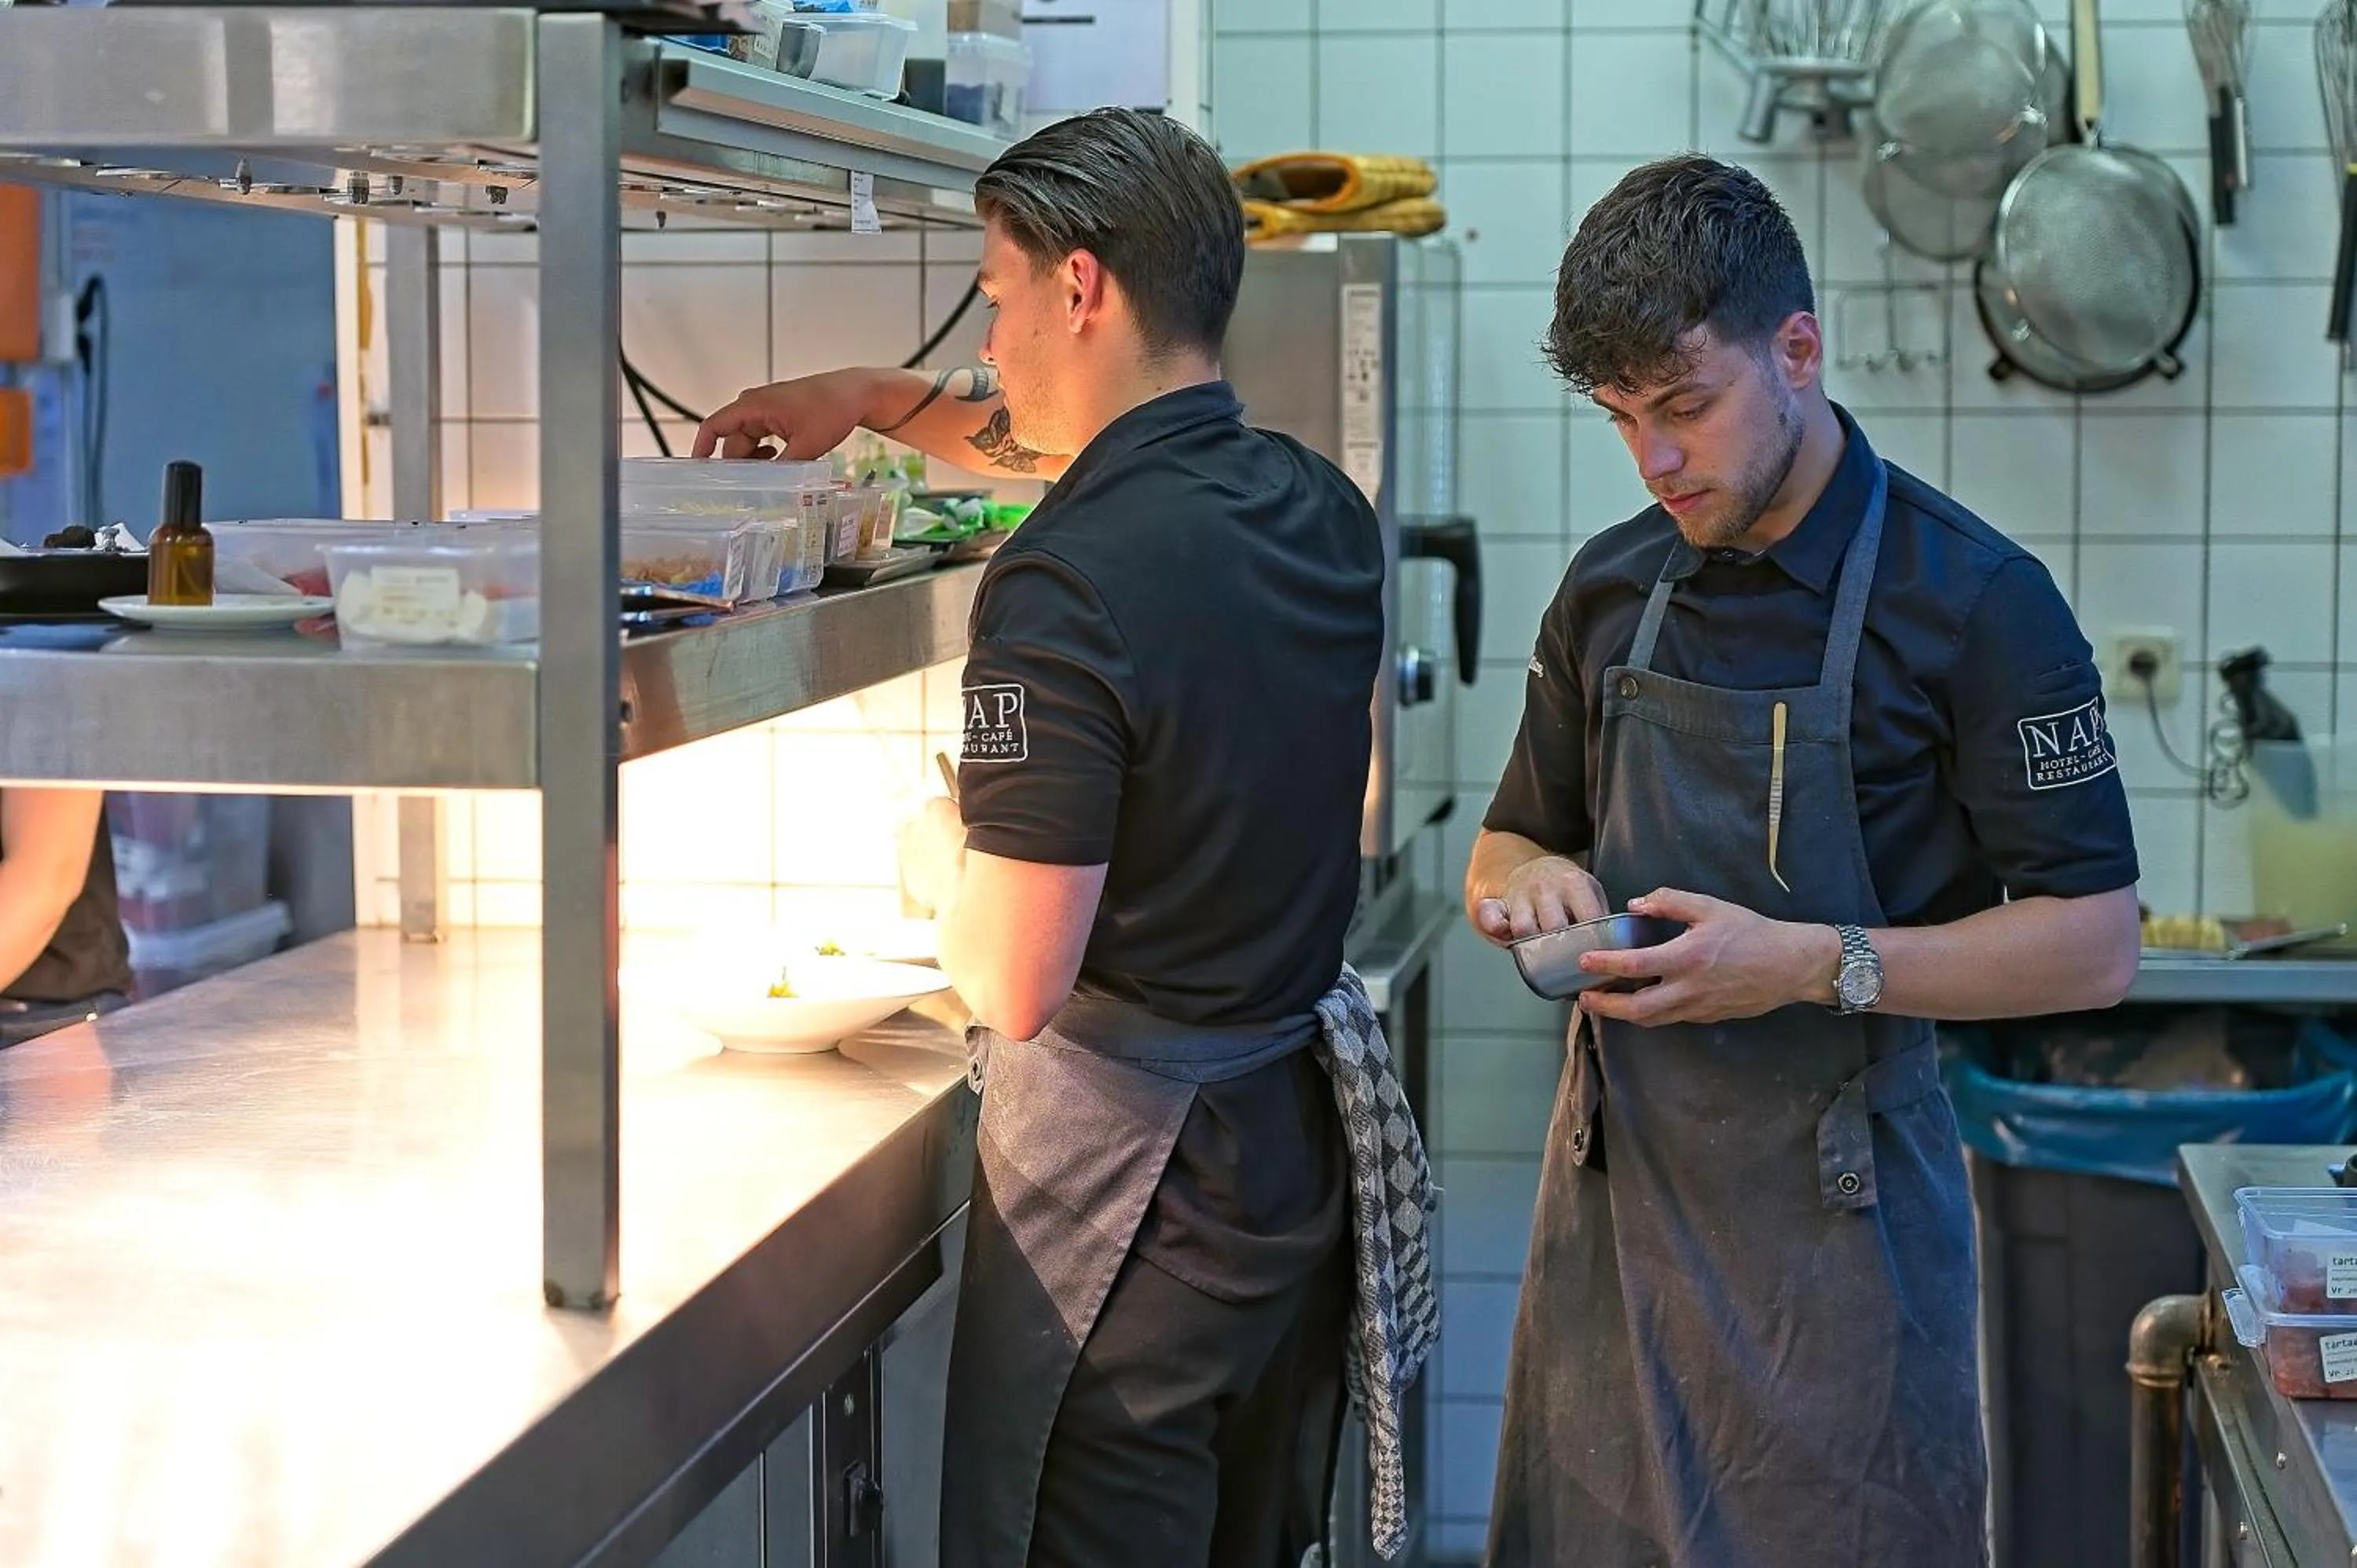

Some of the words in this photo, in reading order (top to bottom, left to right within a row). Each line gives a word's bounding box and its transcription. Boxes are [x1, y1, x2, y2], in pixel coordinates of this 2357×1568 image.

[962, 692, 1018, 729] AP
[981, 729, 1013, 742] CAFÉ
[2025, 706, 2104, 758] NAP
[962, 742, 1019, 753] AURANT
[2040, 755, 2080, 771] HOTEL
